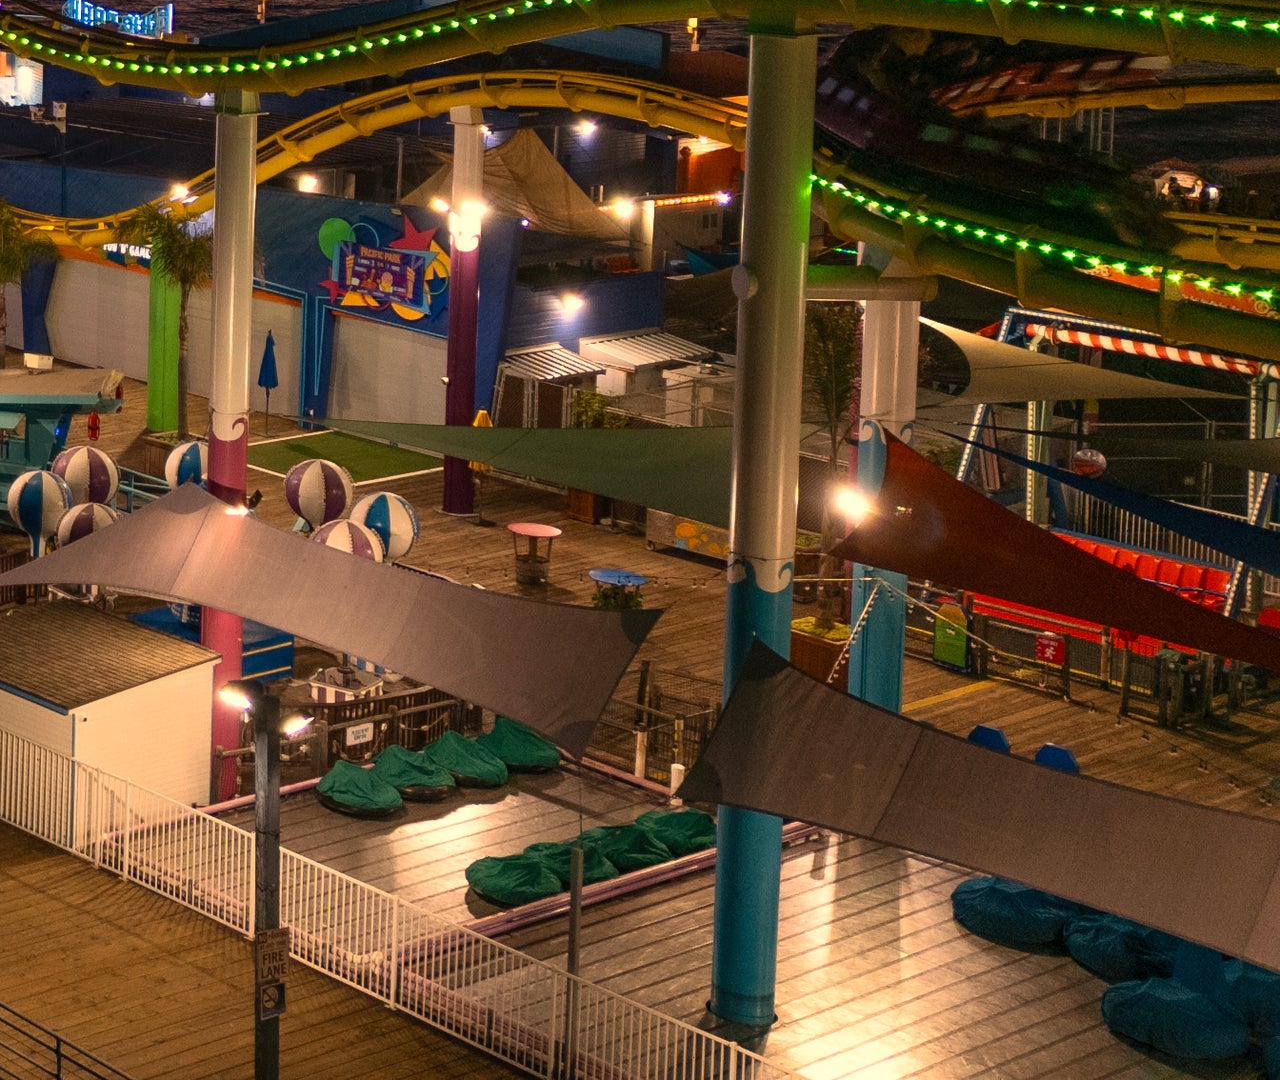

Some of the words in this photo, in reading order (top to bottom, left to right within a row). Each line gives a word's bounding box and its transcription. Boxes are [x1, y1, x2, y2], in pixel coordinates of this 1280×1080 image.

[360, 246, 384, 260] PACIFIC
[384, 252, 401, 264] PARK
[263, 950, 284, 965] FIRE
[261, 963, 287, 978] LANE
